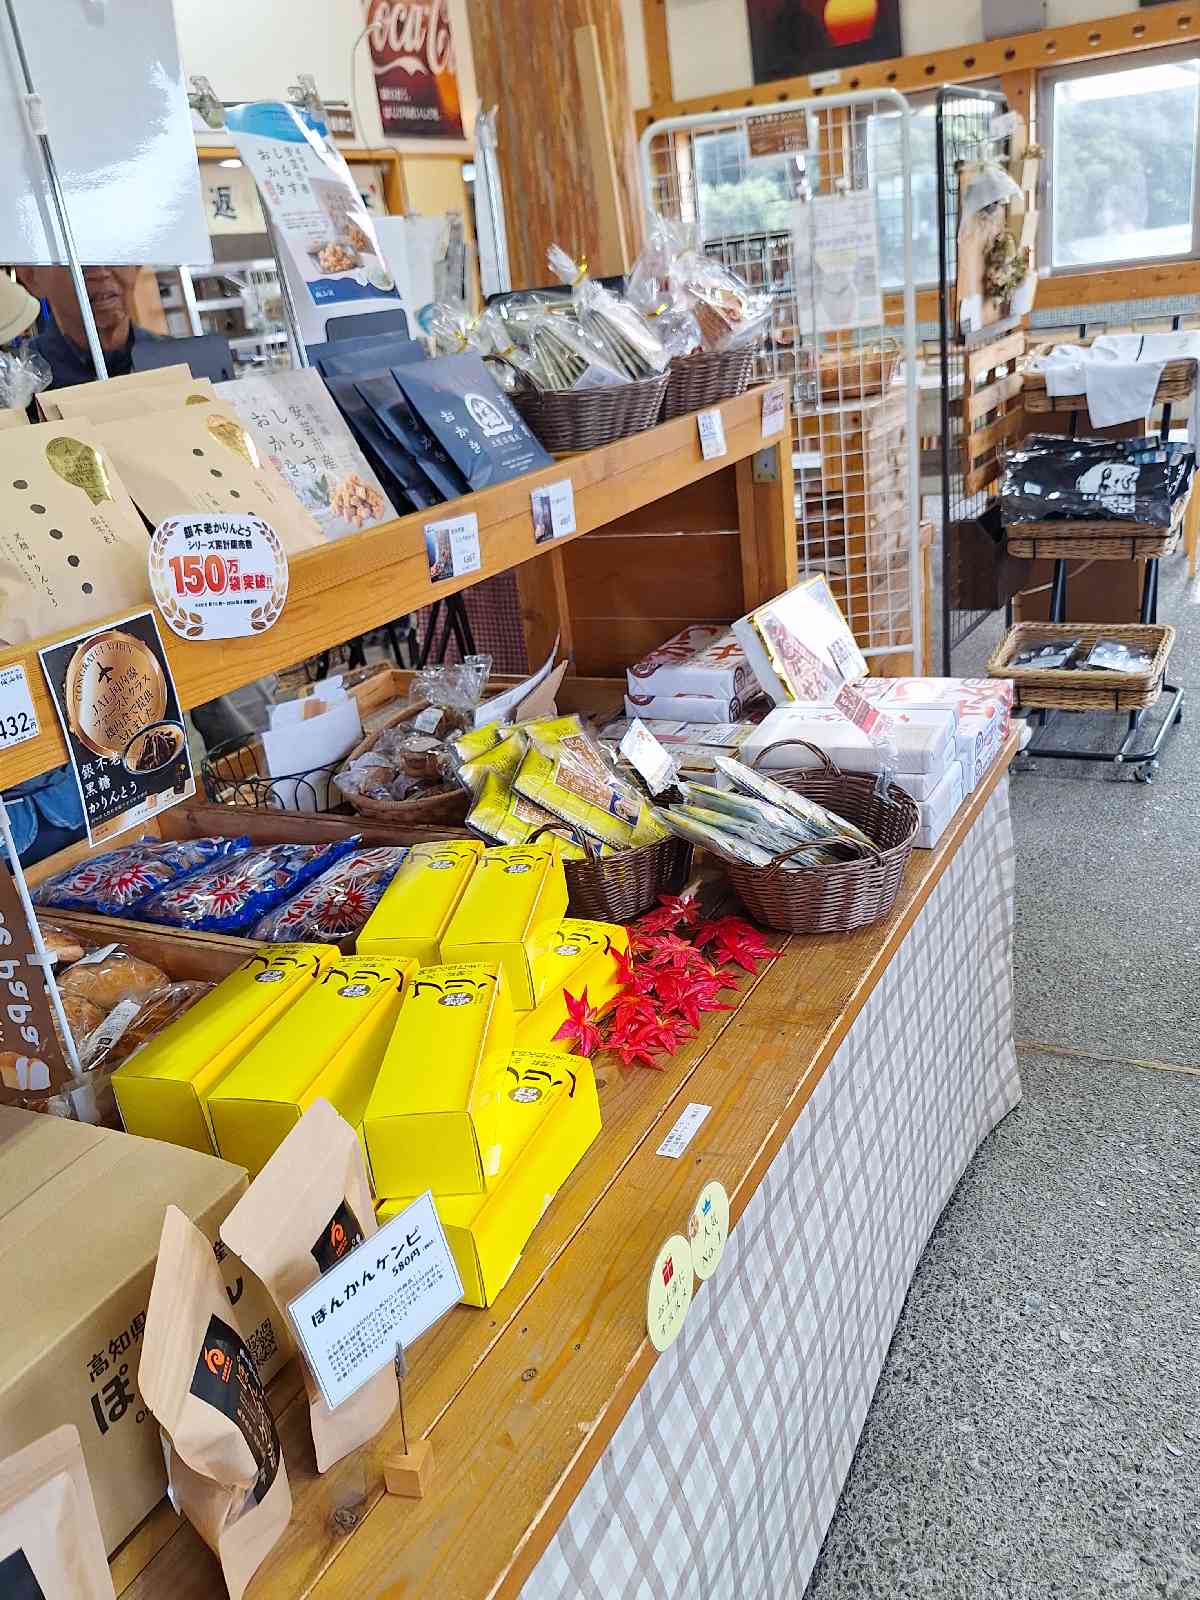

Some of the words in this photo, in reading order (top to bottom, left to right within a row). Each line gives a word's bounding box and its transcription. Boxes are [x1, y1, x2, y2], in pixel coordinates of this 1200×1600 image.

[183, 522, 252, 539] 銀不老かりんとう
[168, 553, 227, 596] 150
[81, 752, 121, 780] 銀不老
[85, 774, 111, 799] 黒糖
[88, 780, 137, 814] かりんとう
[391, 1248, 421, 1278] 580円
[87, 1311, 146, 1383] 高知県
[91, 1363, 135, 1435] ぽ
